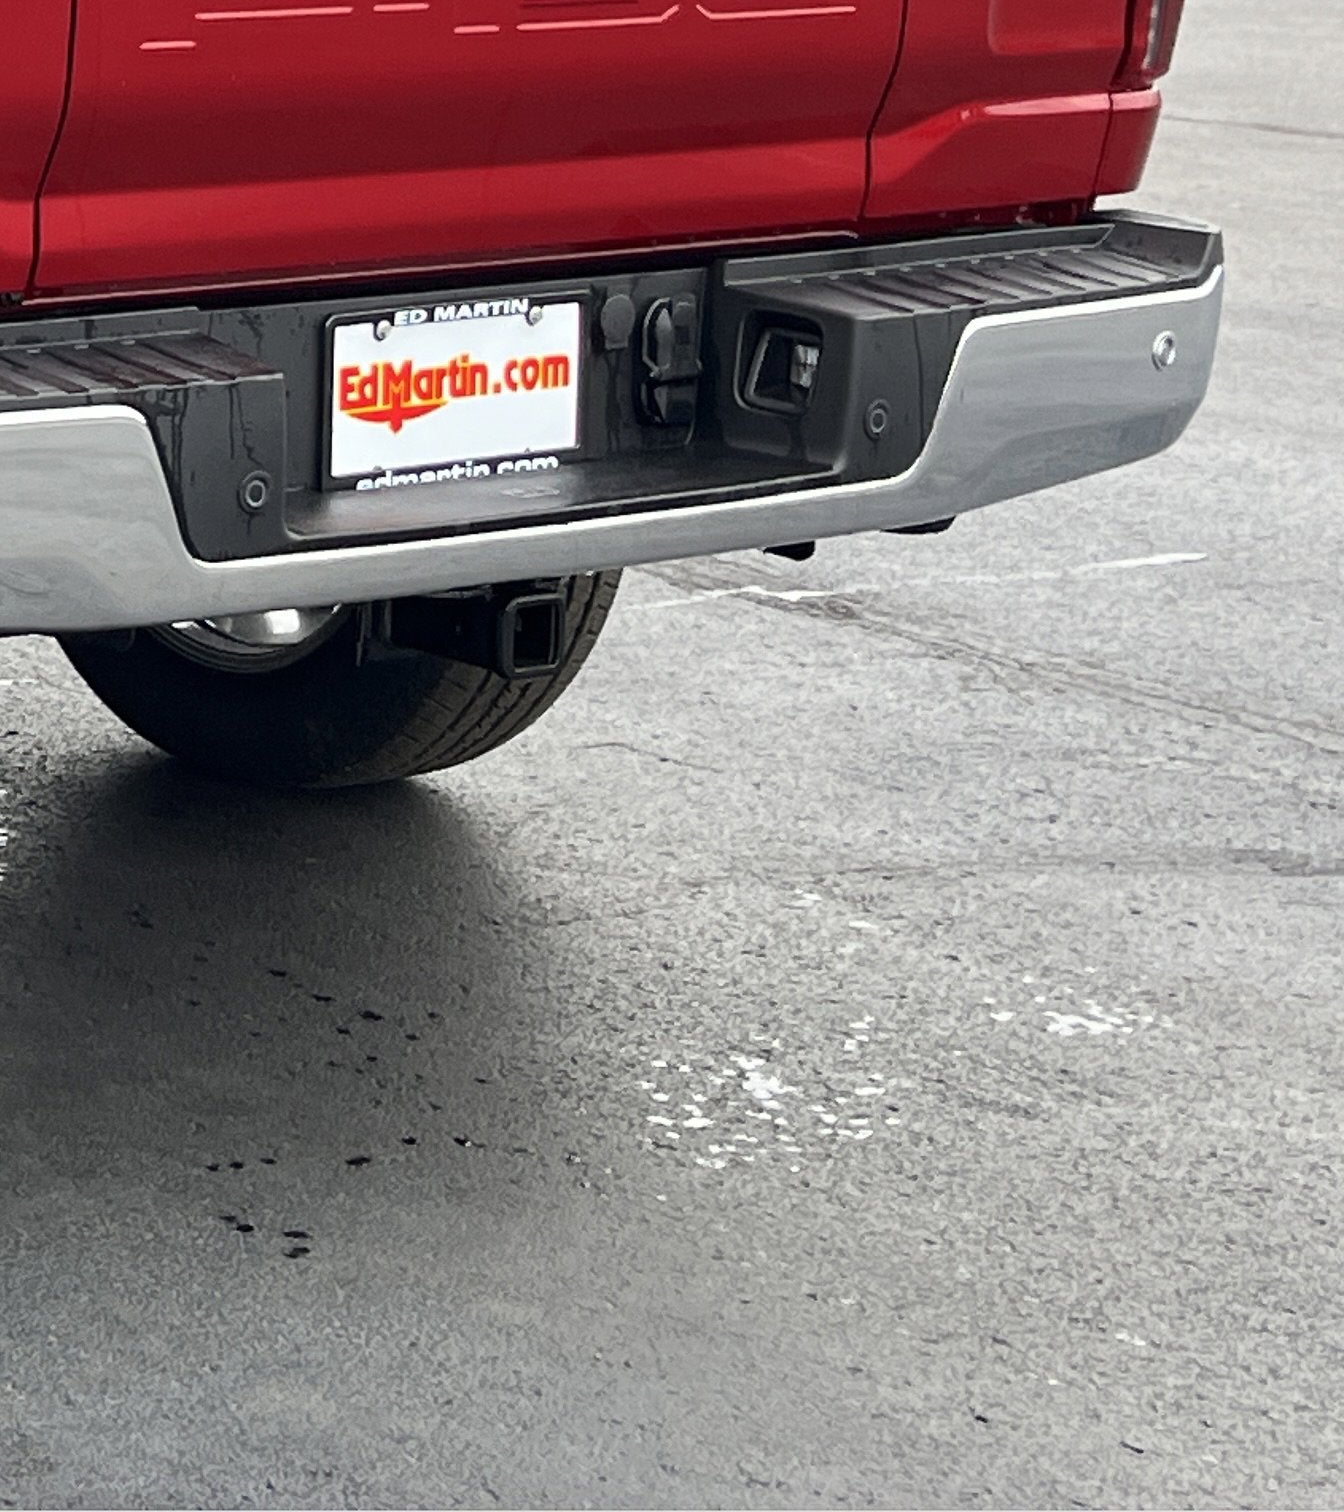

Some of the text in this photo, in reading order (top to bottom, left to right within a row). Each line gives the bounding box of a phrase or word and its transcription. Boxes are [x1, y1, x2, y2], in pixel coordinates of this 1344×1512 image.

[394, 297, 530, 326] ED MARTIN
[339, 353, 571, 412] EdMartin.com
[355, 454, 560, 491] edmartincom
